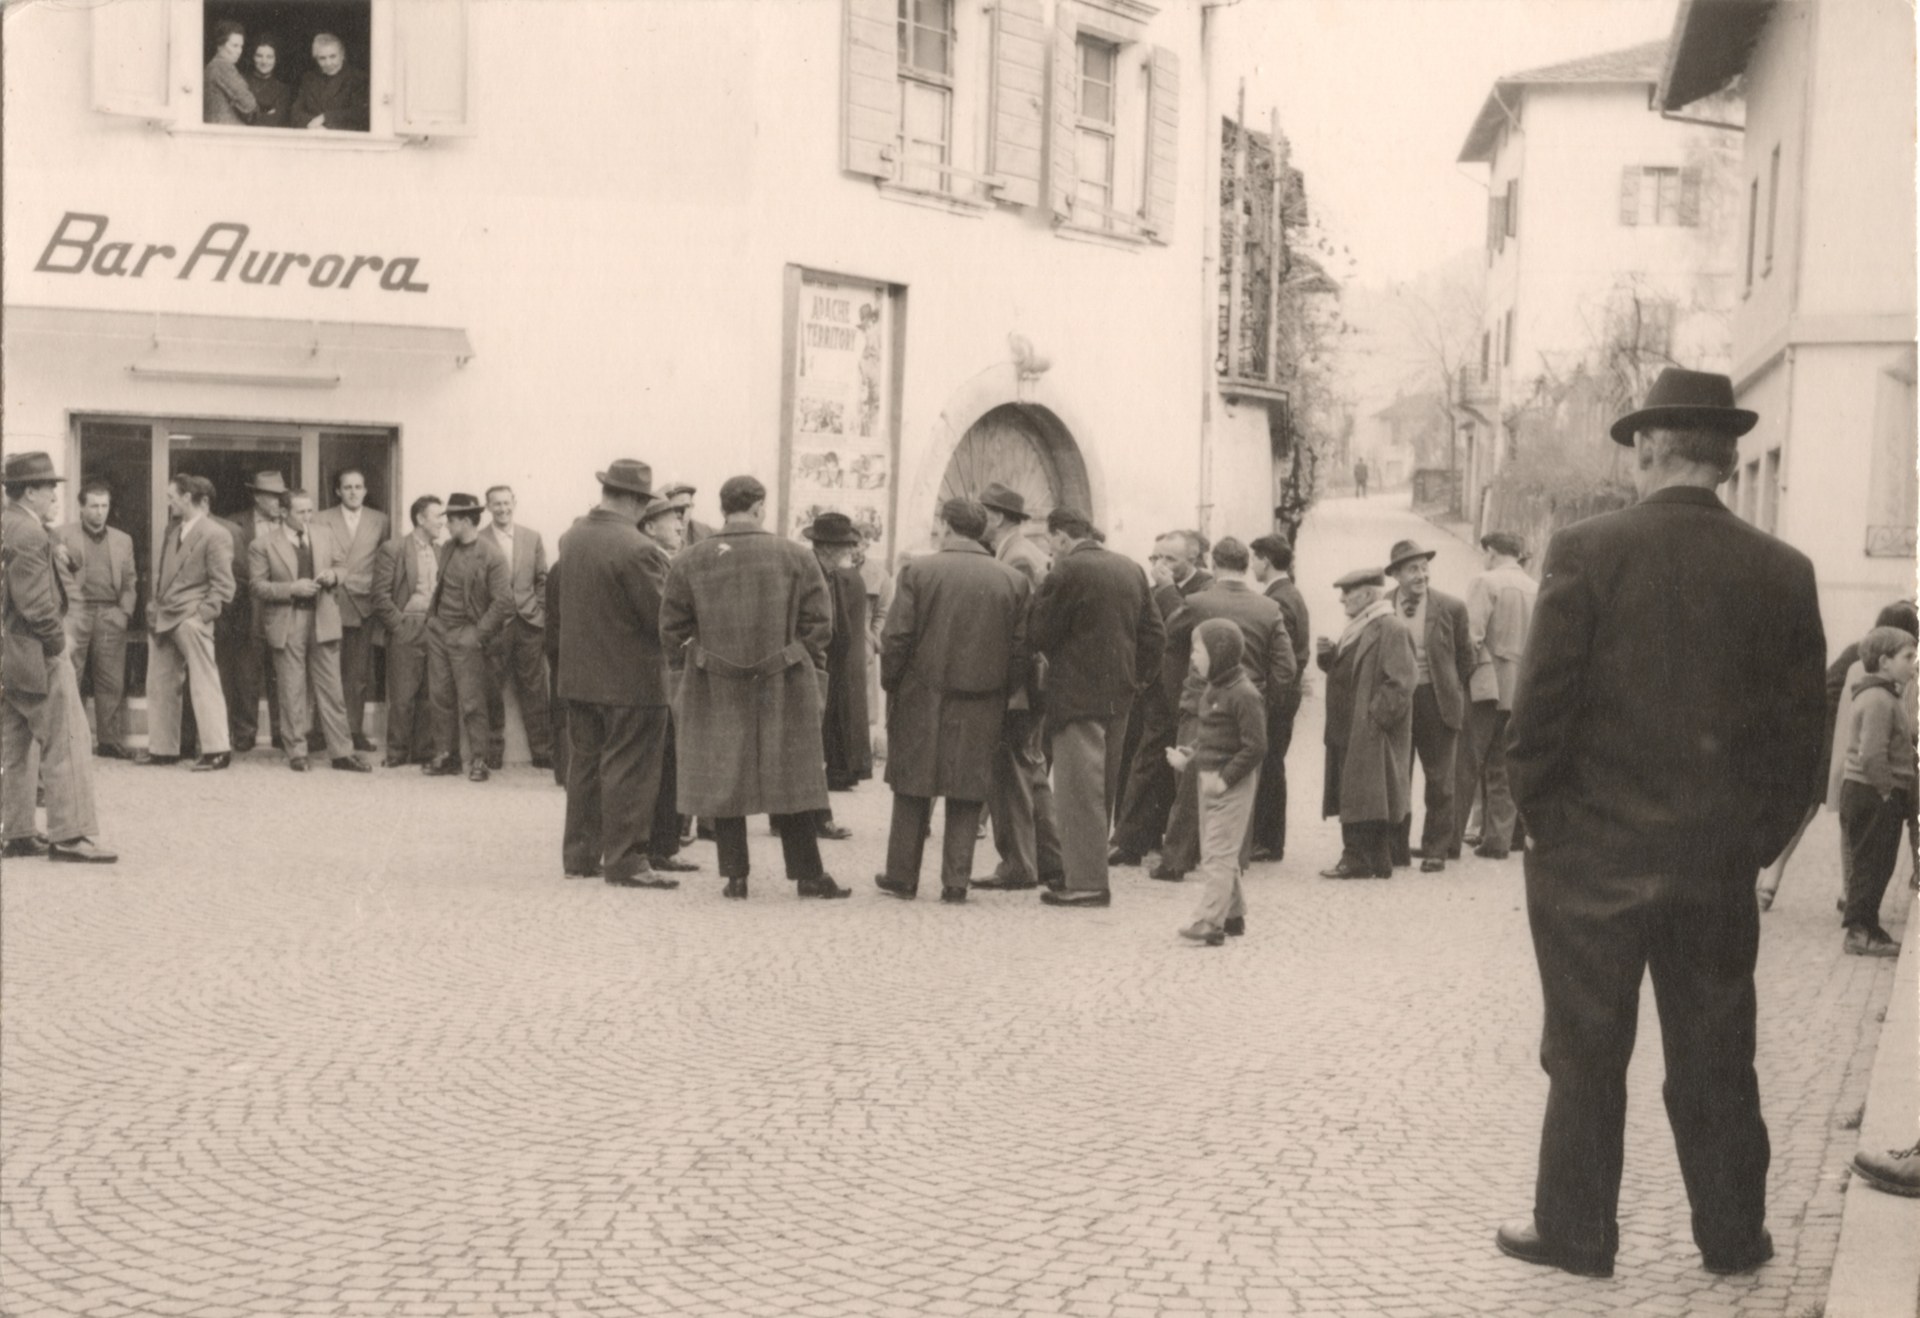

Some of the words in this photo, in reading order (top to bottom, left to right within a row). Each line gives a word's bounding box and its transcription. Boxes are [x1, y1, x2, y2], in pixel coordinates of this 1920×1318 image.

[33, 211, 177, 279] Bar
[176, 221, 430, 293] Aurora
[811, 295, 851, 324] APACHE
[806, 322, 857, 352] TERRITORY
